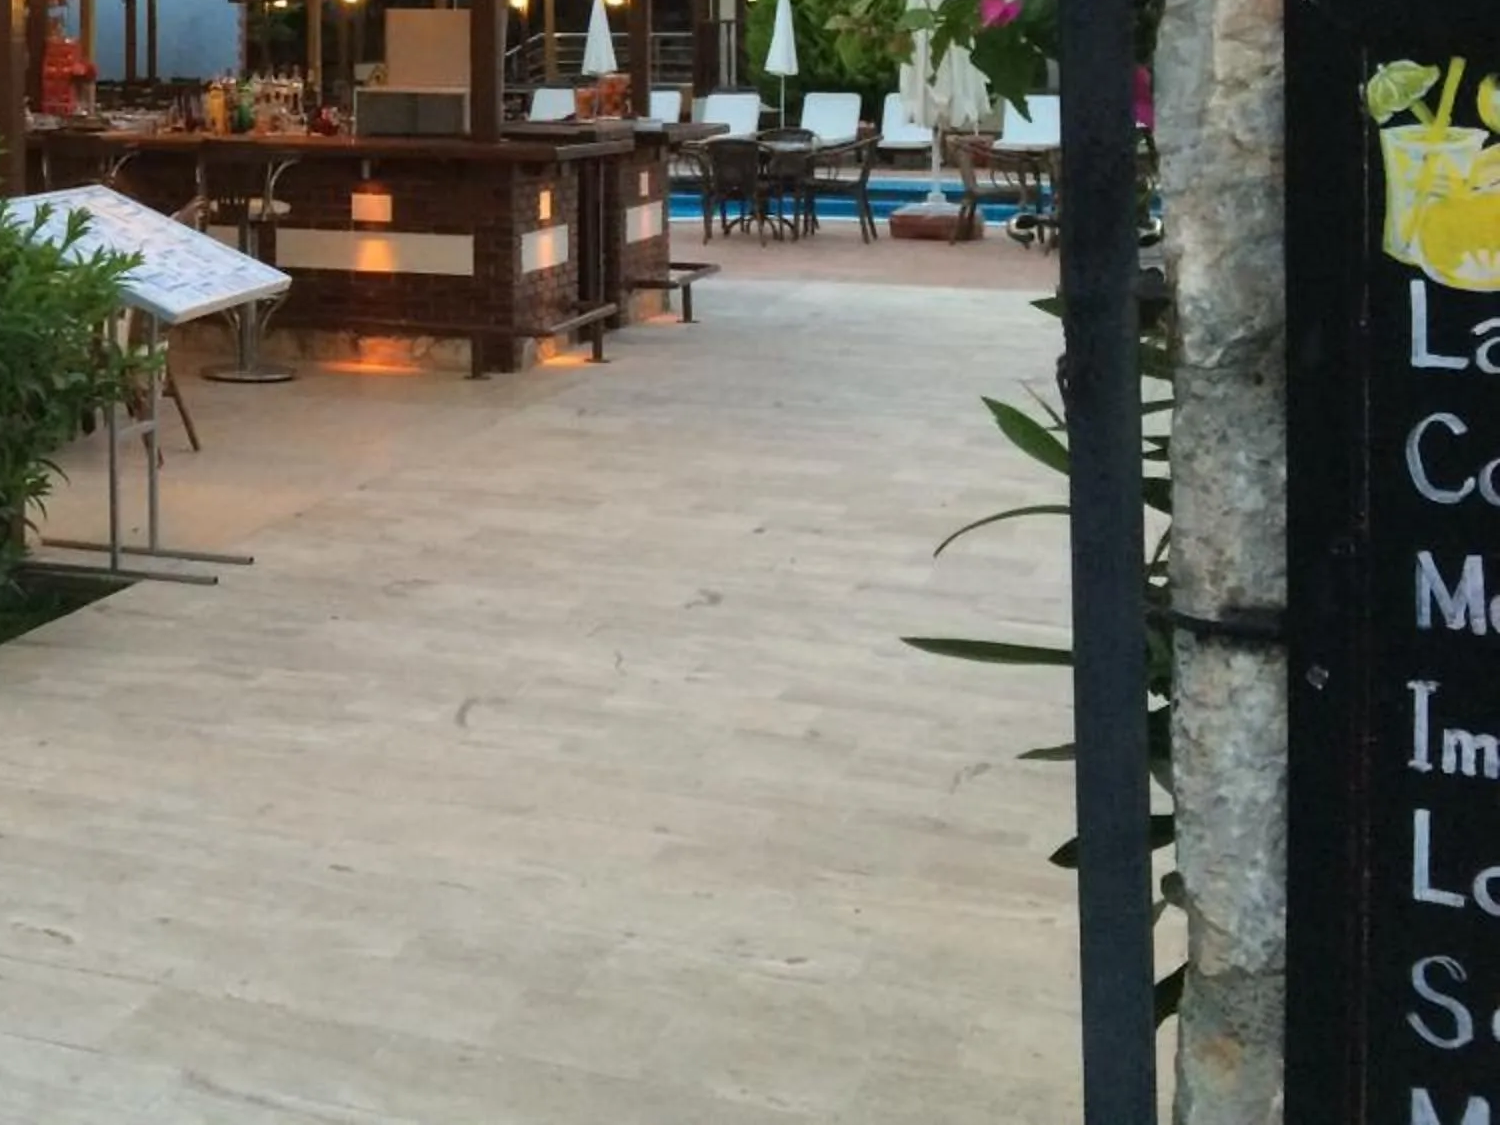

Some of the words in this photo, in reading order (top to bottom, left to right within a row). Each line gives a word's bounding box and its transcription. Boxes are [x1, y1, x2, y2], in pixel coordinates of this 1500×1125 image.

[1415, 549, 1500, 636] M
[1406, 679, 1500, 780] Im
[1406, 955, 1500, 1049] S
